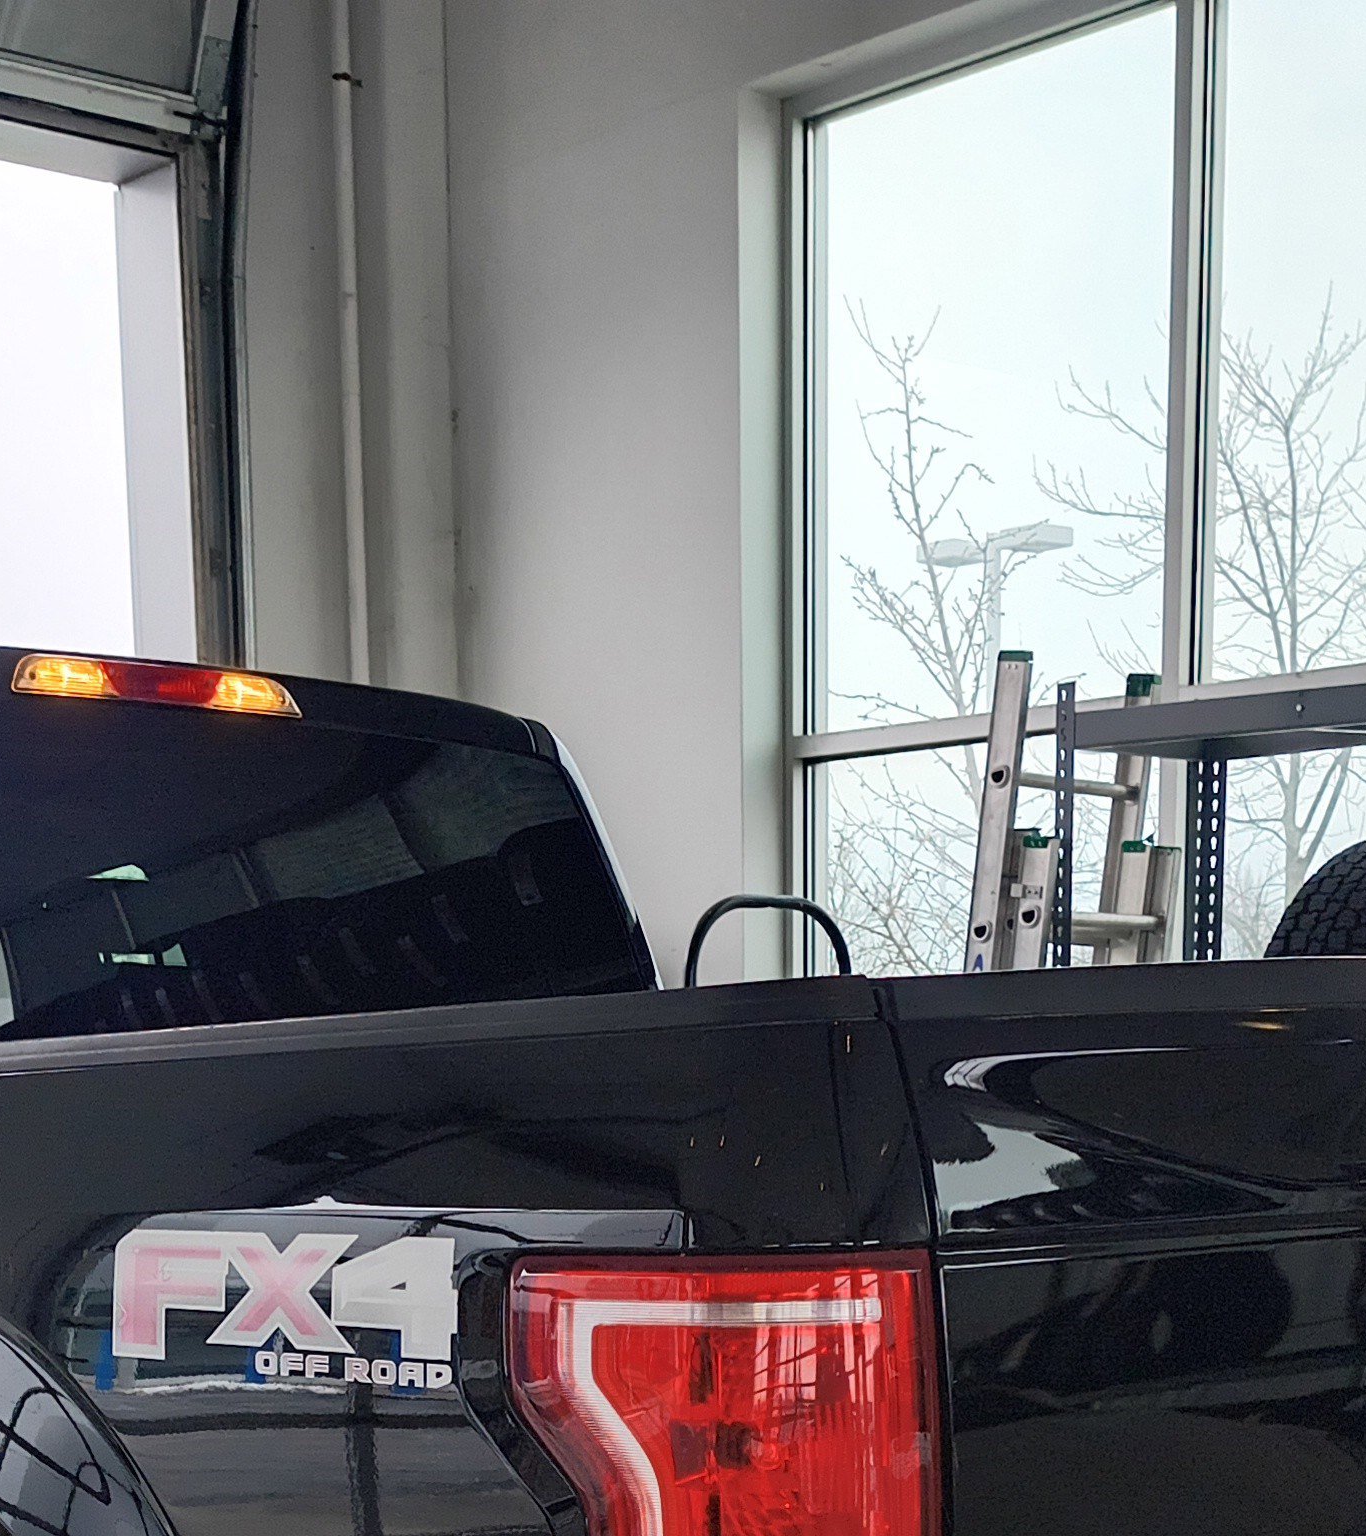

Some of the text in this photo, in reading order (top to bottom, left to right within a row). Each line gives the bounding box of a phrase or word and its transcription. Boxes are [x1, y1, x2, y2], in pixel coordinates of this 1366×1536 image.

[112, 1228, 459, 1362] FX4
[254, 1350, 454, 1390] OFF ROAD
